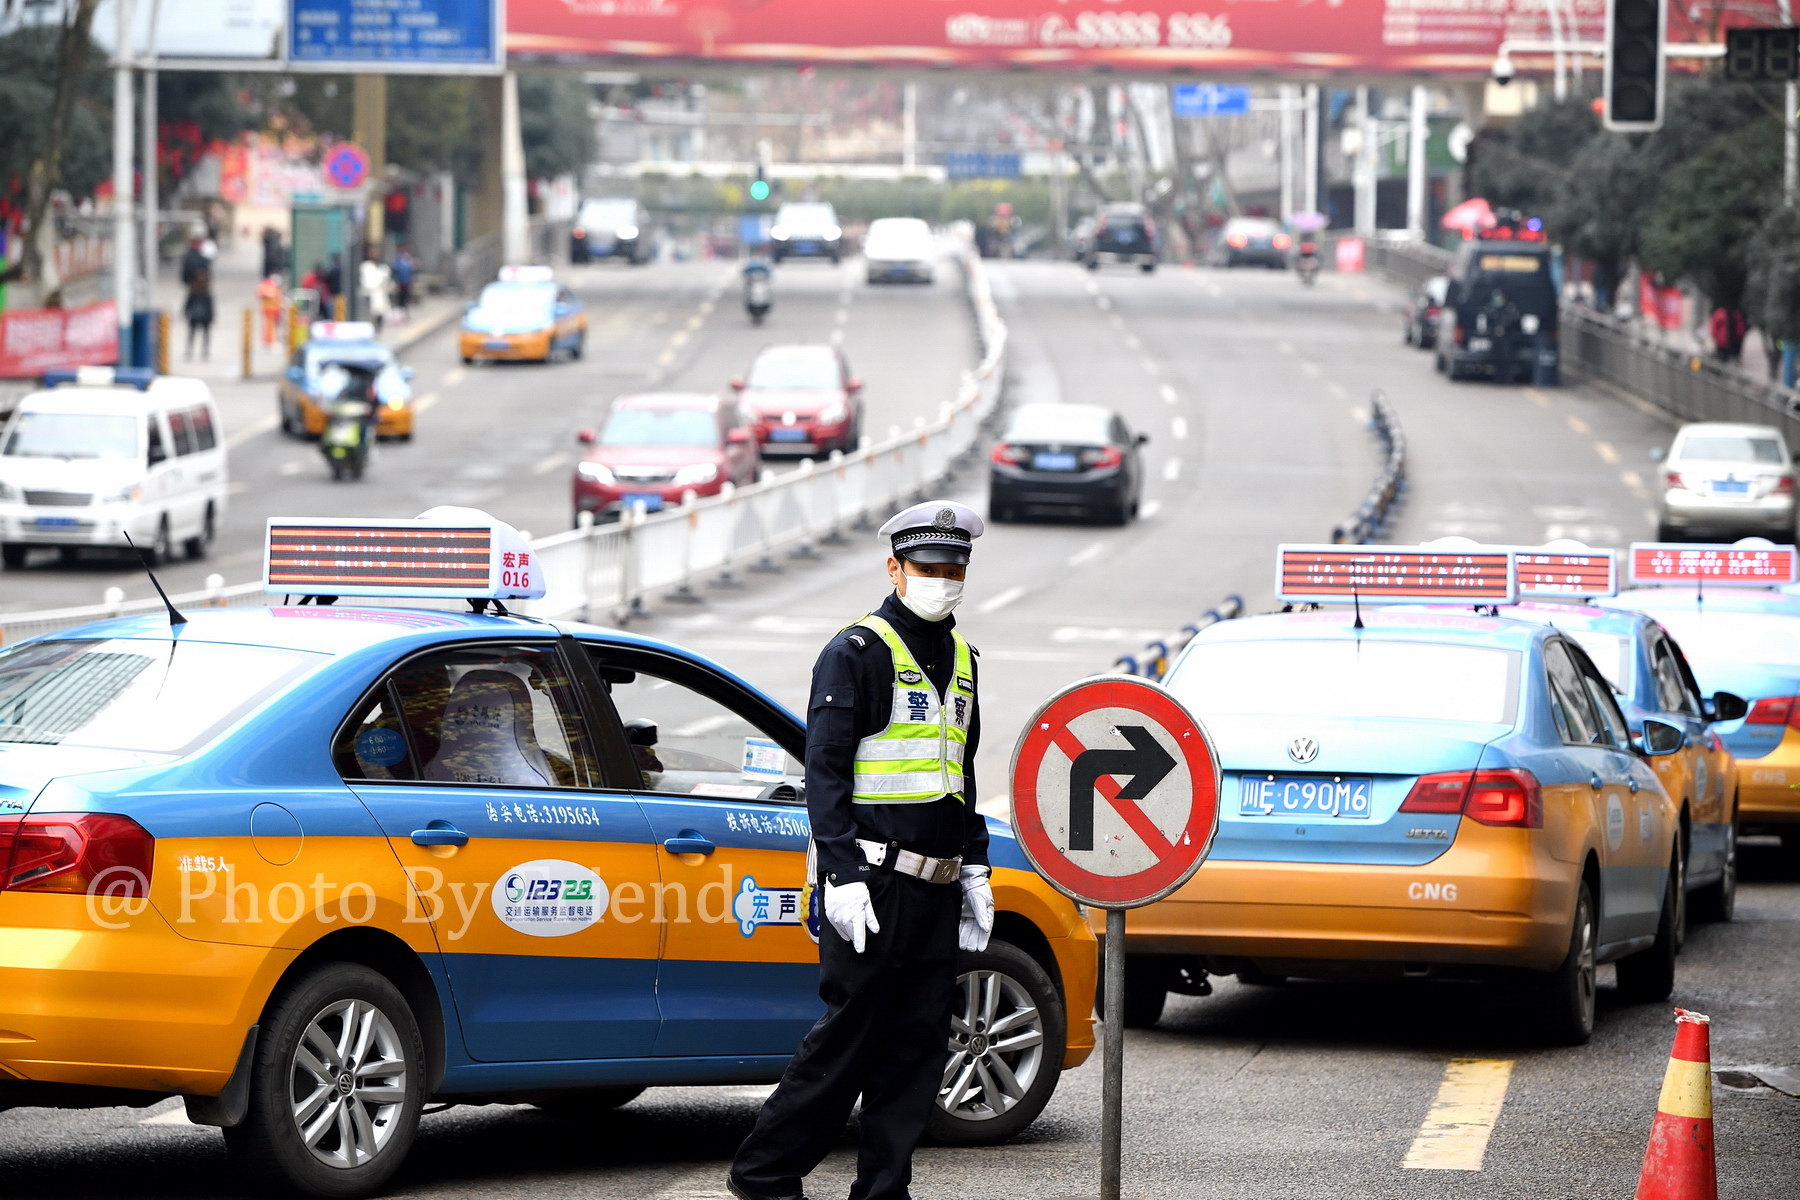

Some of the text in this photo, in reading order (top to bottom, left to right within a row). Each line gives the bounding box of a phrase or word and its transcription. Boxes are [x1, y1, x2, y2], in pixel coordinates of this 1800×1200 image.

[503, 552, 530, 568] 宏声
[503, 571, 529, 588] 016
[726, 811, 812, 837] 投诉电话:2506
[1405, 828, 1449, 839] JETTA
[526, 879, 596, 900] 12328
[1408, 882, 1458, 902] CNG
[505, 906, 593, 917] 交通运输服务监督电话
[752, 893, 796, 920] 宏声
